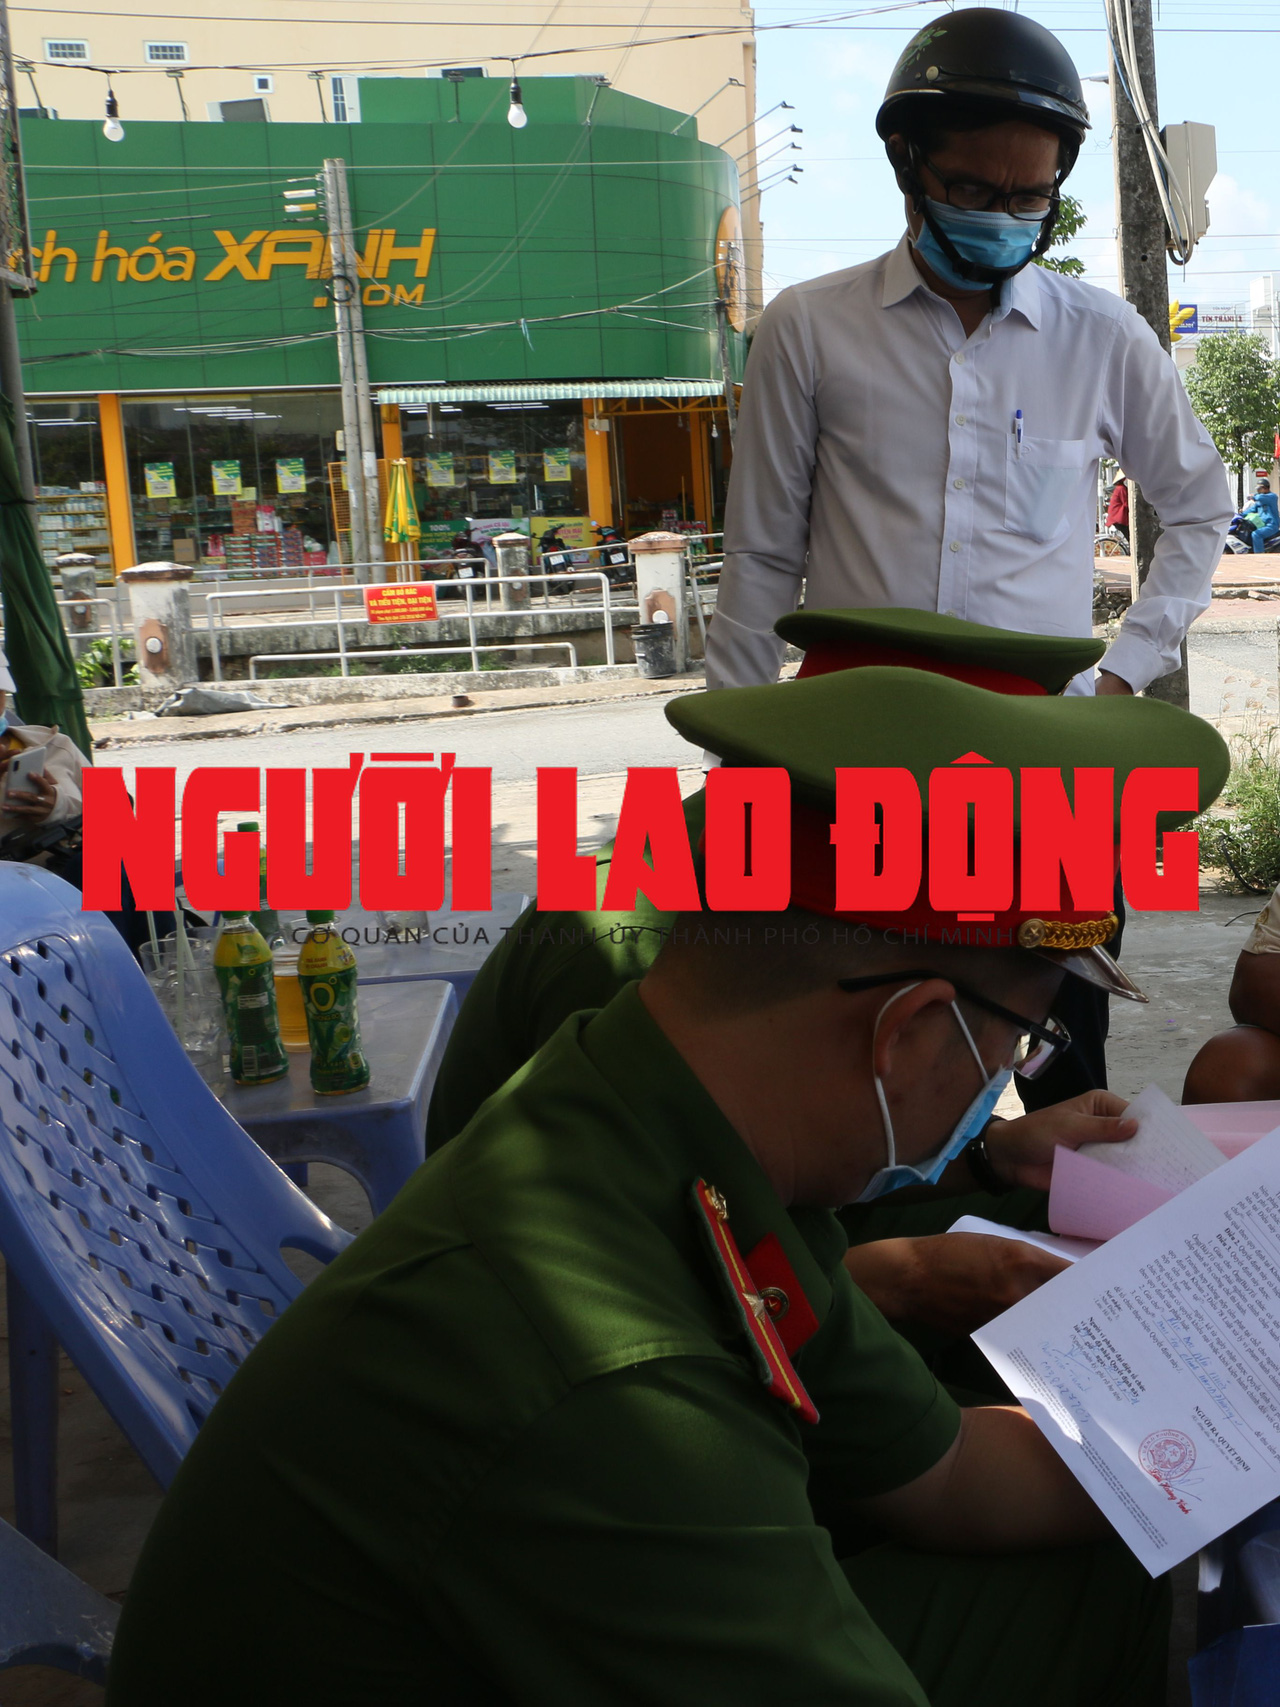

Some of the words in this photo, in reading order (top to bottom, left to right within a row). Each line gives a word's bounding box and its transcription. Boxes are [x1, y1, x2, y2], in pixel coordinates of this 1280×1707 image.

[91, 229, 196, 283] hóa
[313, 284, 425, 308] .OM
[1192, 1405, 1213, 1428] NGƯỜI
[1216, 1434, 1238, 1459] QUYẾT
[1233, 1454, 1251, 1473] ĐỊNH
